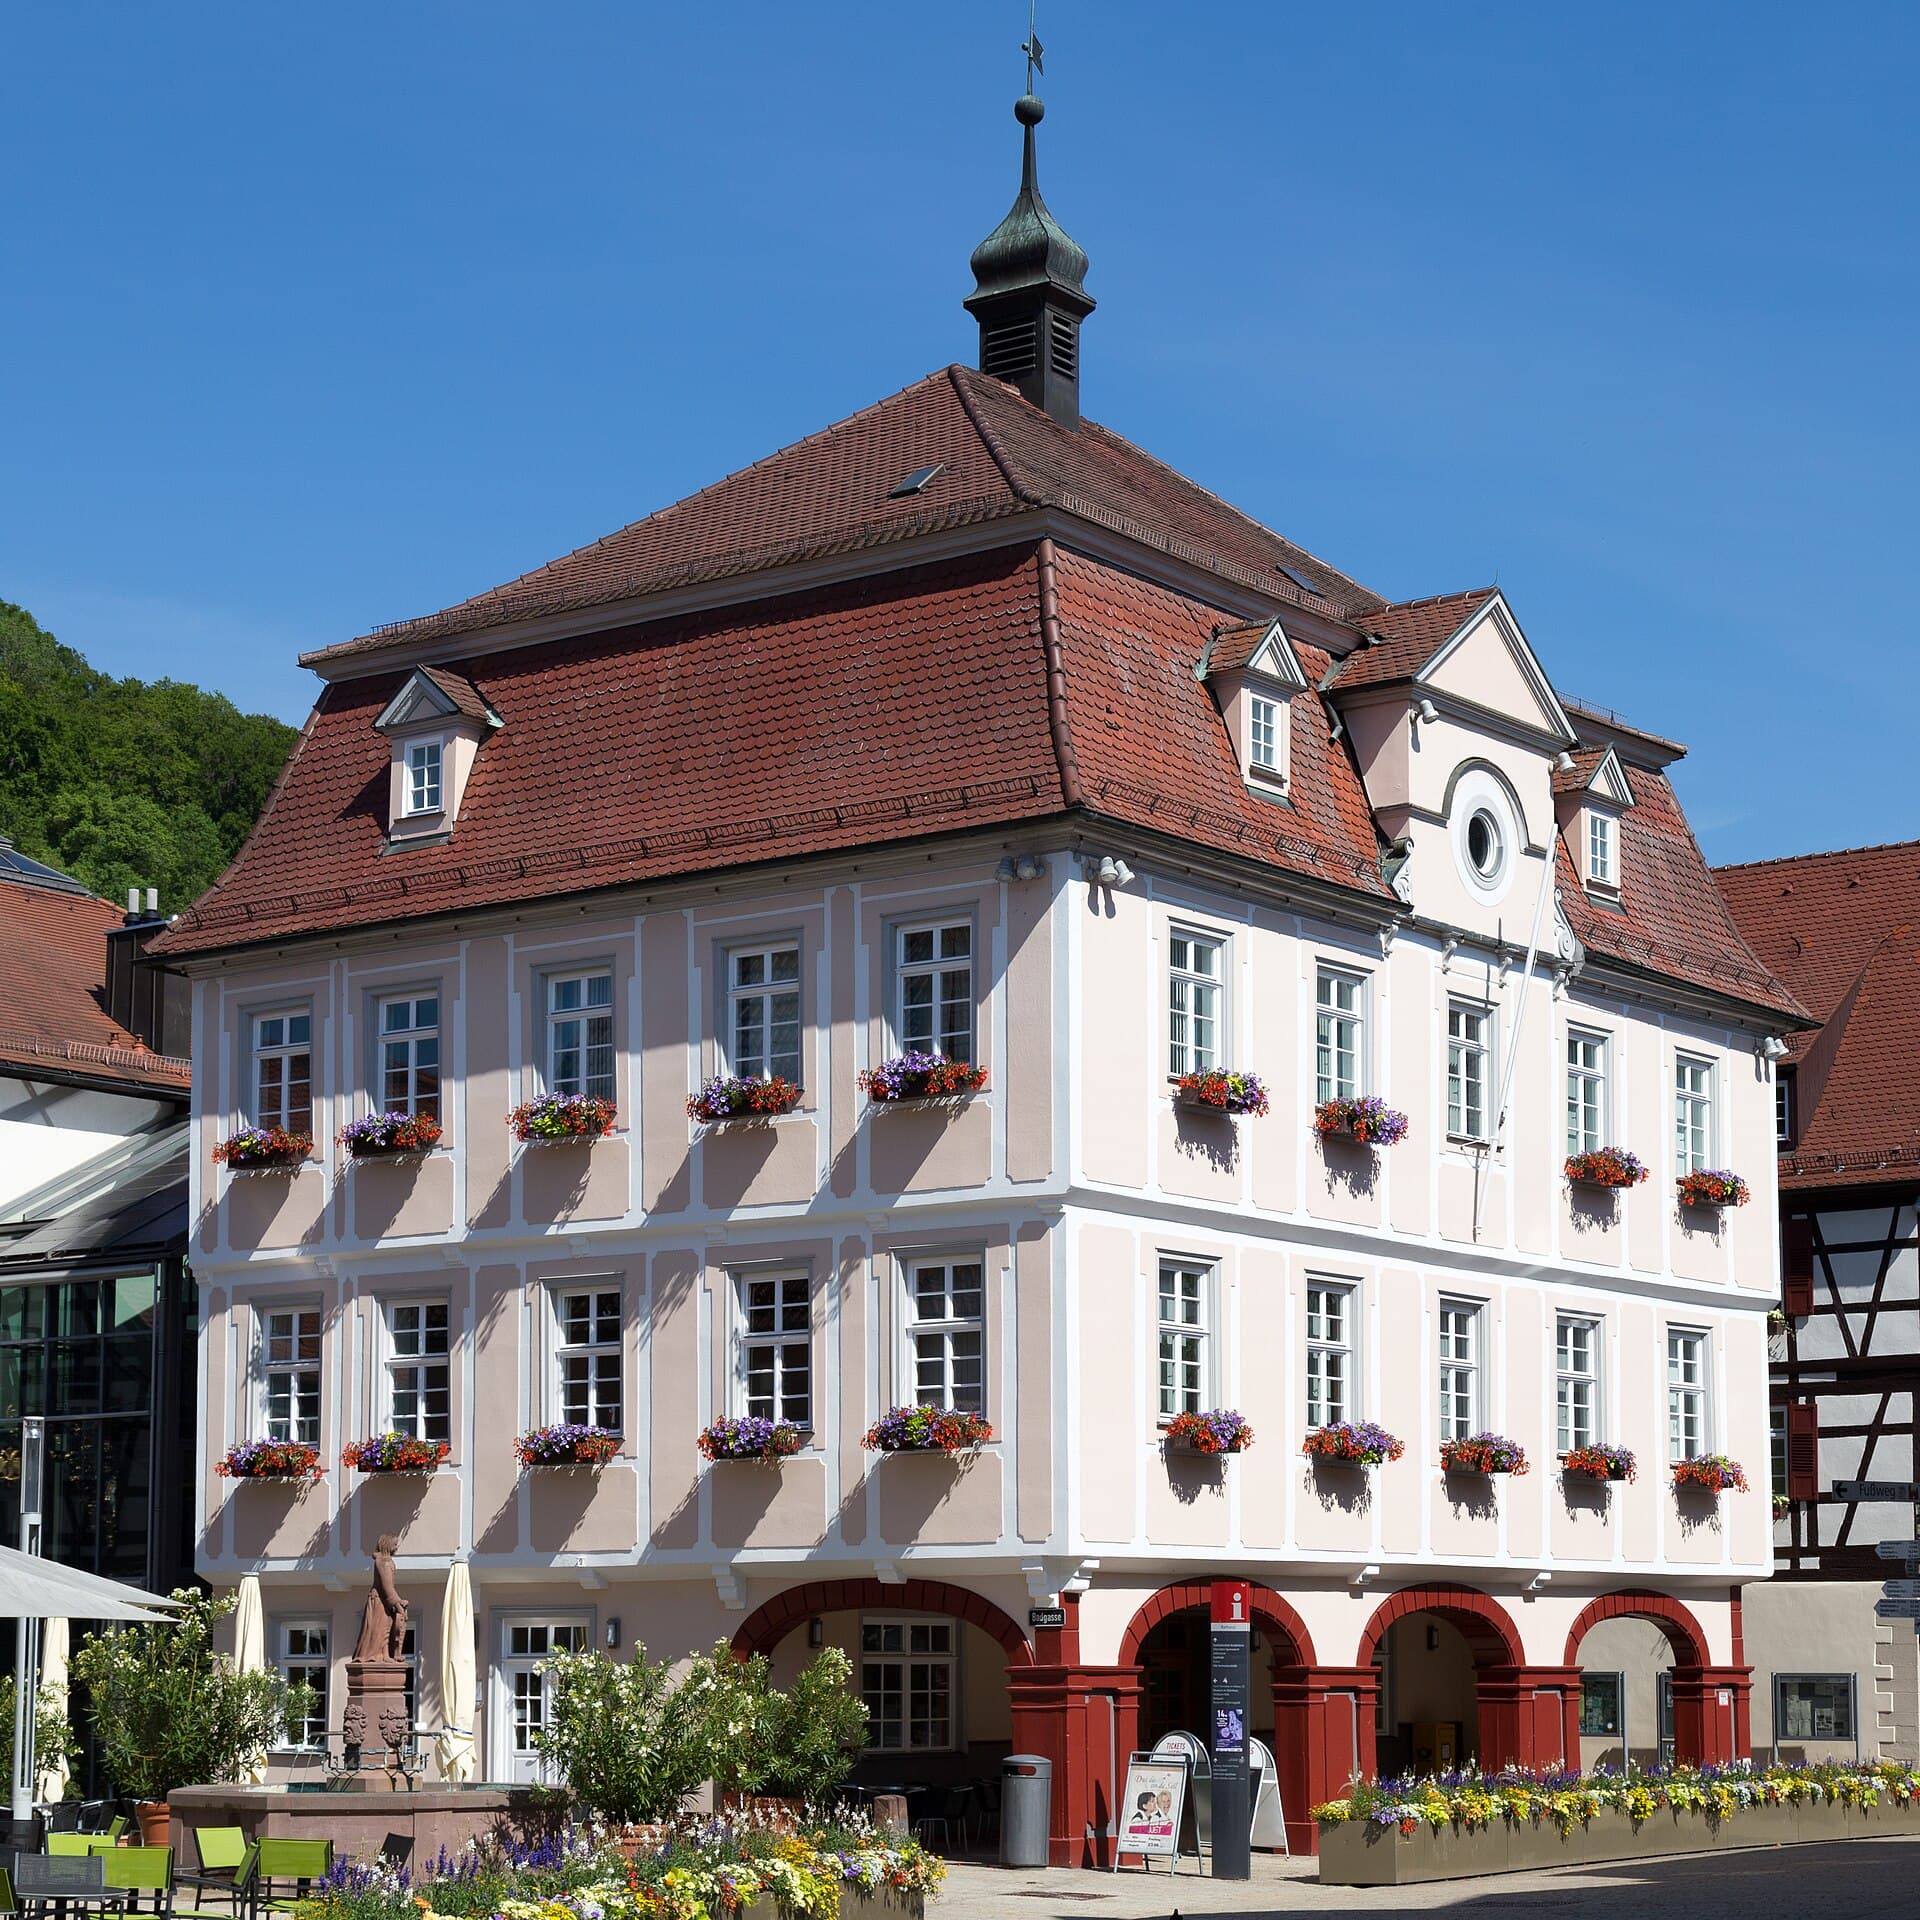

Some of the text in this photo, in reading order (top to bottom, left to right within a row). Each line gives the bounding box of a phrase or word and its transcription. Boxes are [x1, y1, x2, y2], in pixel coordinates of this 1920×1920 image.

[1859, 1483, 1896, 1499] Fußweg
[1031, 1612, 1062, 1624] Badgasse
[1166, 1742, 1186, 1750] TICKETS
